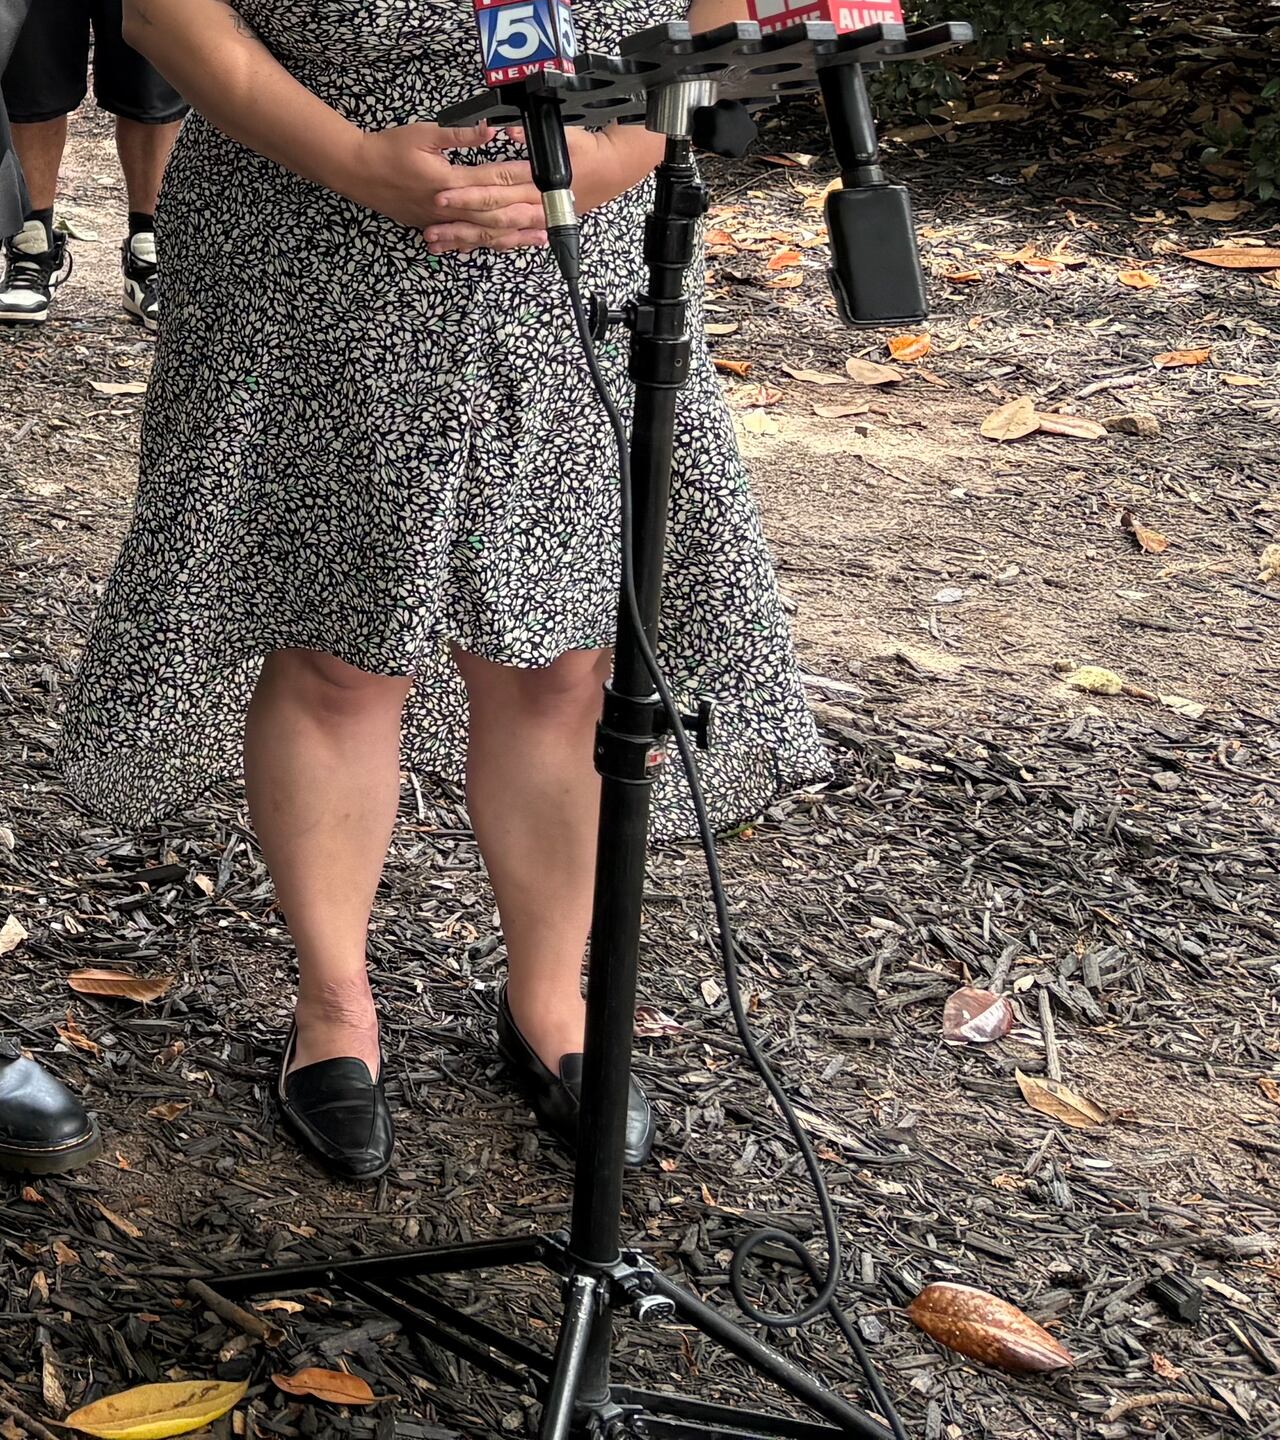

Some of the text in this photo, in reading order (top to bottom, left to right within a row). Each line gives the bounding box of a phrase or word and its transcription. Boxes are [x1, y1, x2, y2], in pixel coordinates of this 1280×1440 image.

[496, 4, 541, 60] 5
[558, 5, 576, 58] 5
[490, 60, 558, 81] NEWS
